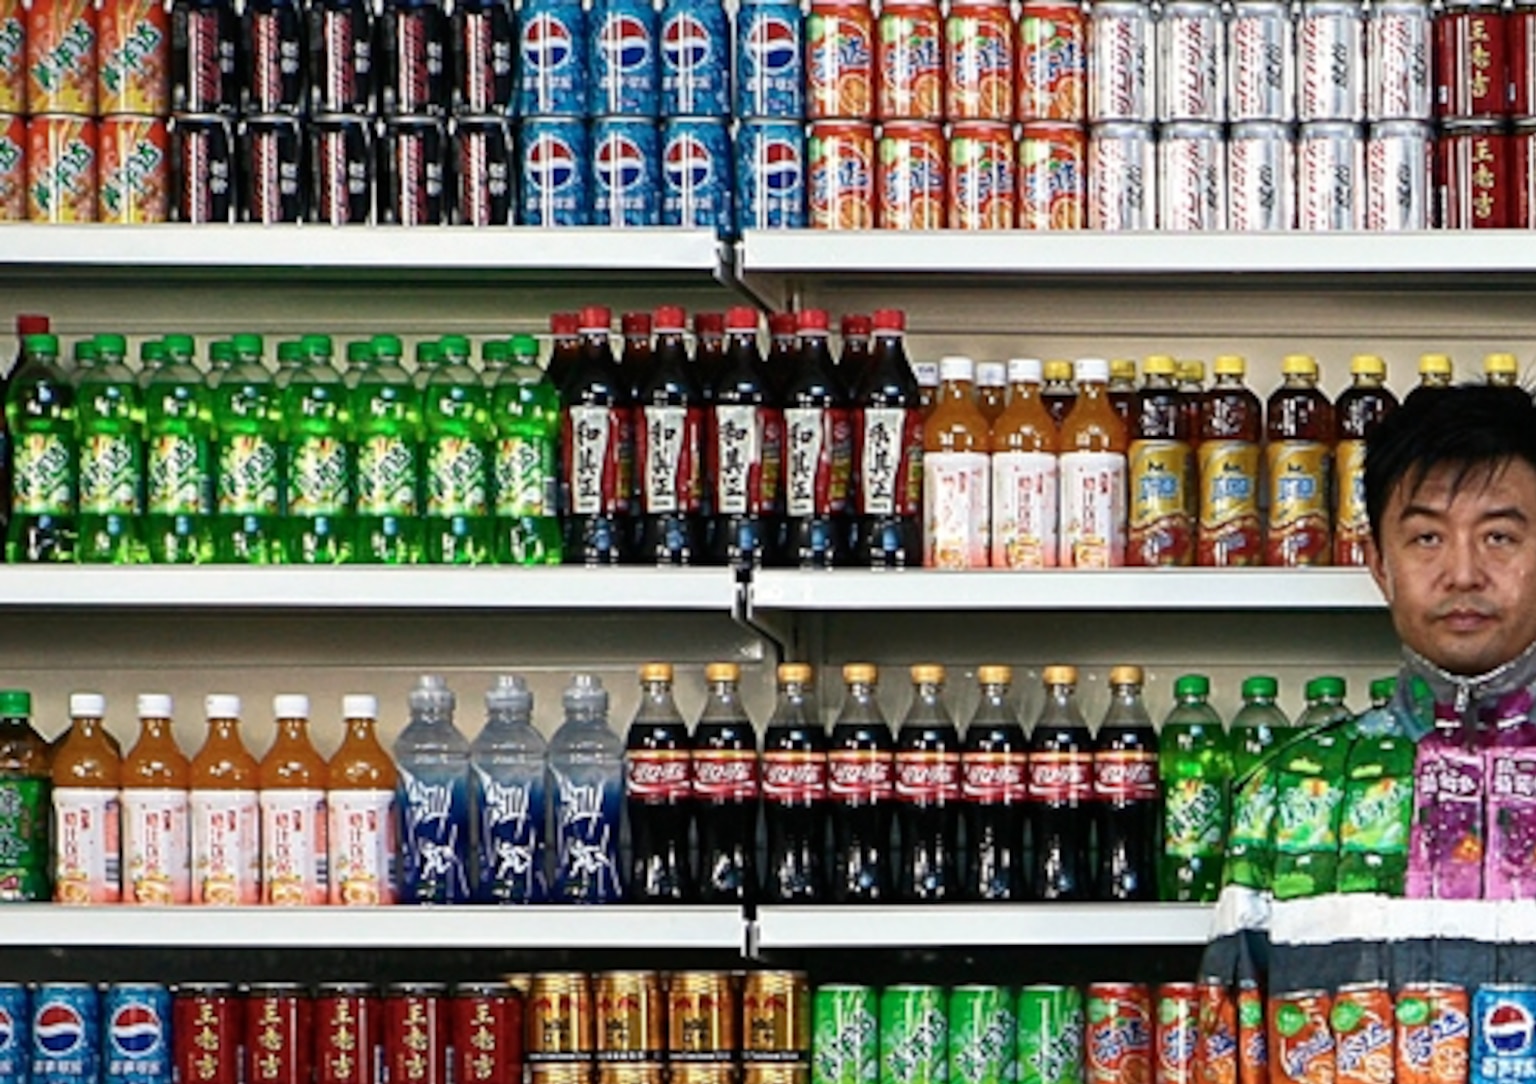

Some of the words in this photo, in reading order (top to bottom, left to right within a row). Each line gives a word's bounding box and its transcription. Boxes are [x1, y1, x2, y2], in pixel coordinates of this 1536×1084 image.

[194, 1003, 219, 1080] 王老吉
[258, 1003, 284, 1080] 王老吉
[330, 1003, 356, 1080] 王老吉
[402, 1003, 429, 1080] 王老吉
[470, 1003, 495, 1080] 王老吉
